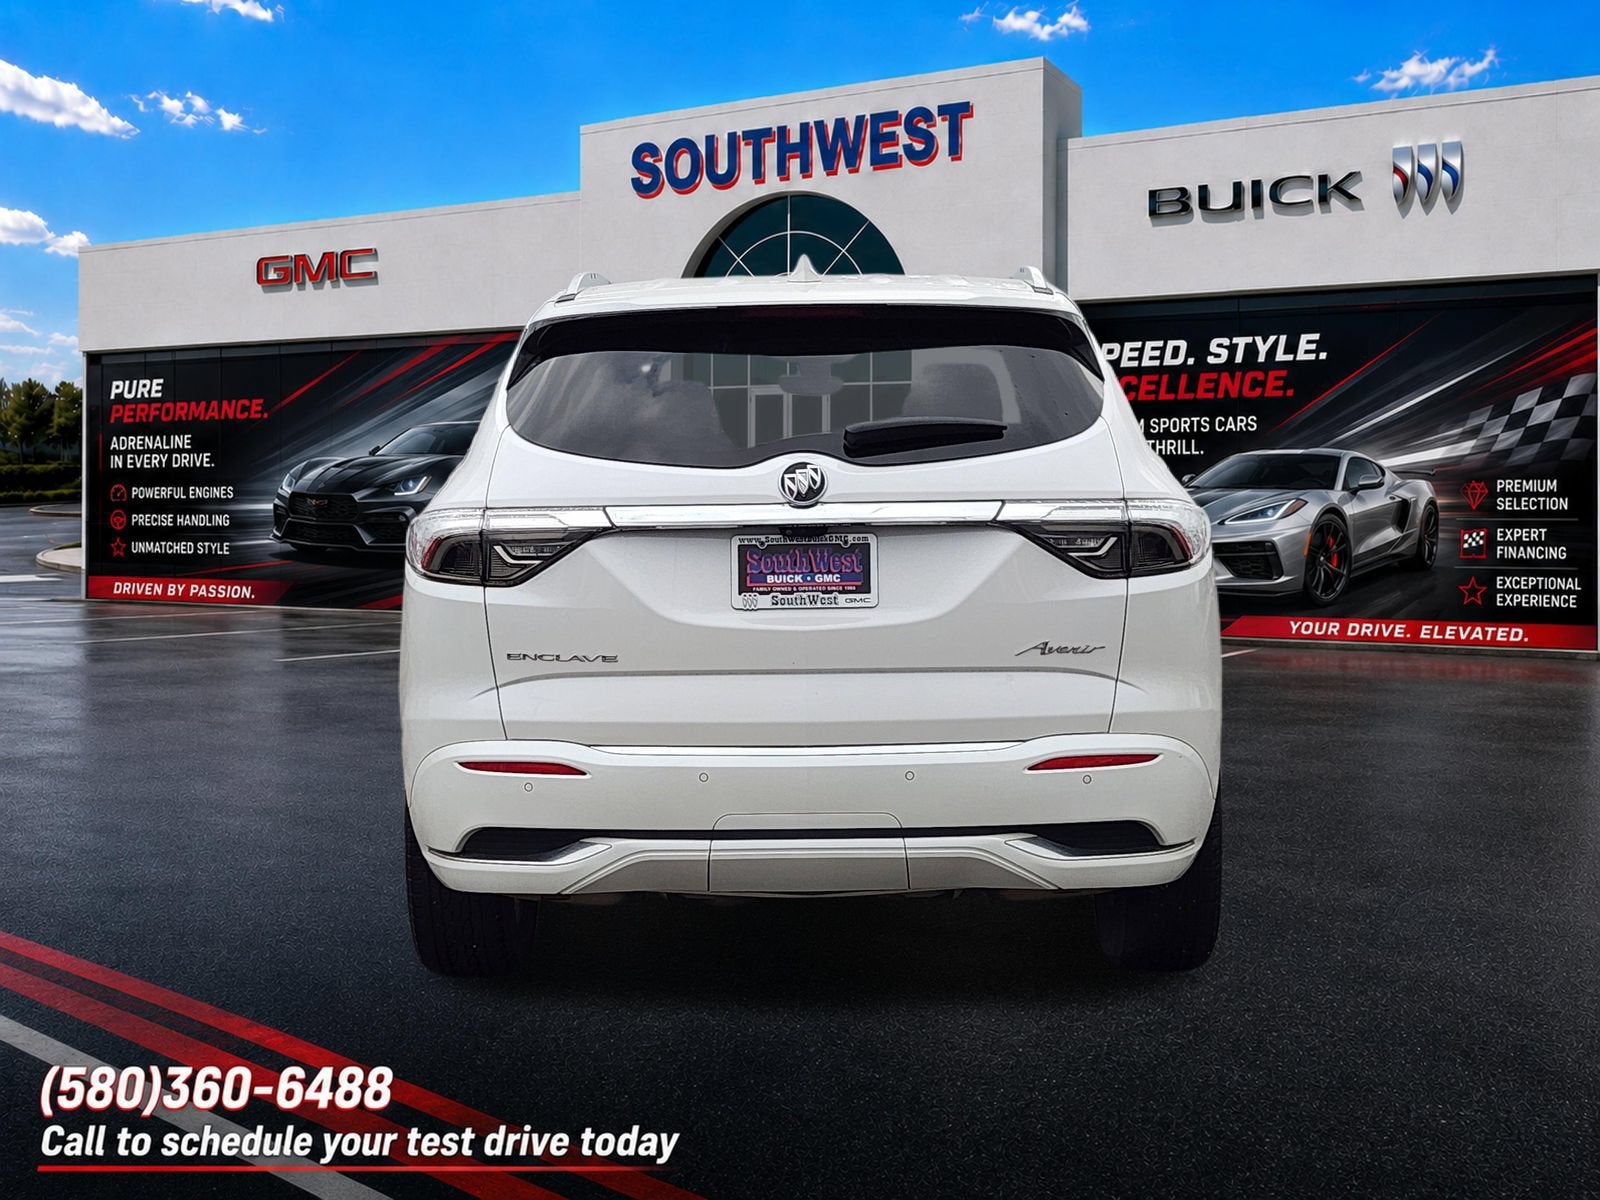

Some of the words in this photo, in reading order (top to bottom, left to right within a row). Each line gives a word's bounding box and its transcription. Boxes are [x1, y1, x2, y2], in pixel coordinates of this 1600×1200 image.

[631, 101, 974, 200] SOUTHWEST
[1148, 171, 1362, 219] BUICK
[256, 248, 378, 286] GMC
[1100, 340, 1195, 367] PEED.
[1207, 333, 1328, 365] STYLE.
[110, 378, 164, 400] PURE
[1118, 369, 1294, 402] CELLENCE.
[110, 398, 269, 424] PERFORMANCE.
[1149, 417, 1210, 433] SPORTS
[1216, 416, 1258, 432] CARS
[110, 434, 192, 450] ADRENALINE
[1147, 439, 1205, 456] THRILL.
[110, 454, 123, 469] IN
[126, 454, 169, 468] EVERY
[172, 453, 215, 468] DRIVE.
[131, 486, 187, 499] POWERFUL
[189, 486, 234, 499] ENGINES
[1496, 479, 1558, 493] PREMIUM
[1496, 497, 1569, 511] SELECTION
[131, 513, 174, 527] PRECISE
[176, 513, 230, 527] HANDLING
[1496, 528, 1548, 542] EXPERT
[131, 541, 194, 554] UNMATCHED
[196, 541, 230, 555] STYLE
[1496, 545, 1567, 560] FINANCING
[747, 548, 863, 574] SouthWest
[766, 574, 803, 583] BUICK
[814, 573, 841, 583] GMC
[1496, 576, 1582, 591] EXCEPTIONAL
[113, 581, 163, 596] DRIVEN
[167, 583, 186, 596] BY
[189, 584, 255, 599] PASSION.
[771, 594, 839, 606] SouthWest
[1496, 593, 1577, 608] EXPERIENCE
[1289, 620, 1340, 636] YOUR
[1346, 623, 1411, 639] DRIVE.
[1419, 625, 1528, 643] ELEVATED.
[1014, 640, 1106, 656] Avenir
[506, 653, 619, 663] ENCLAVE
